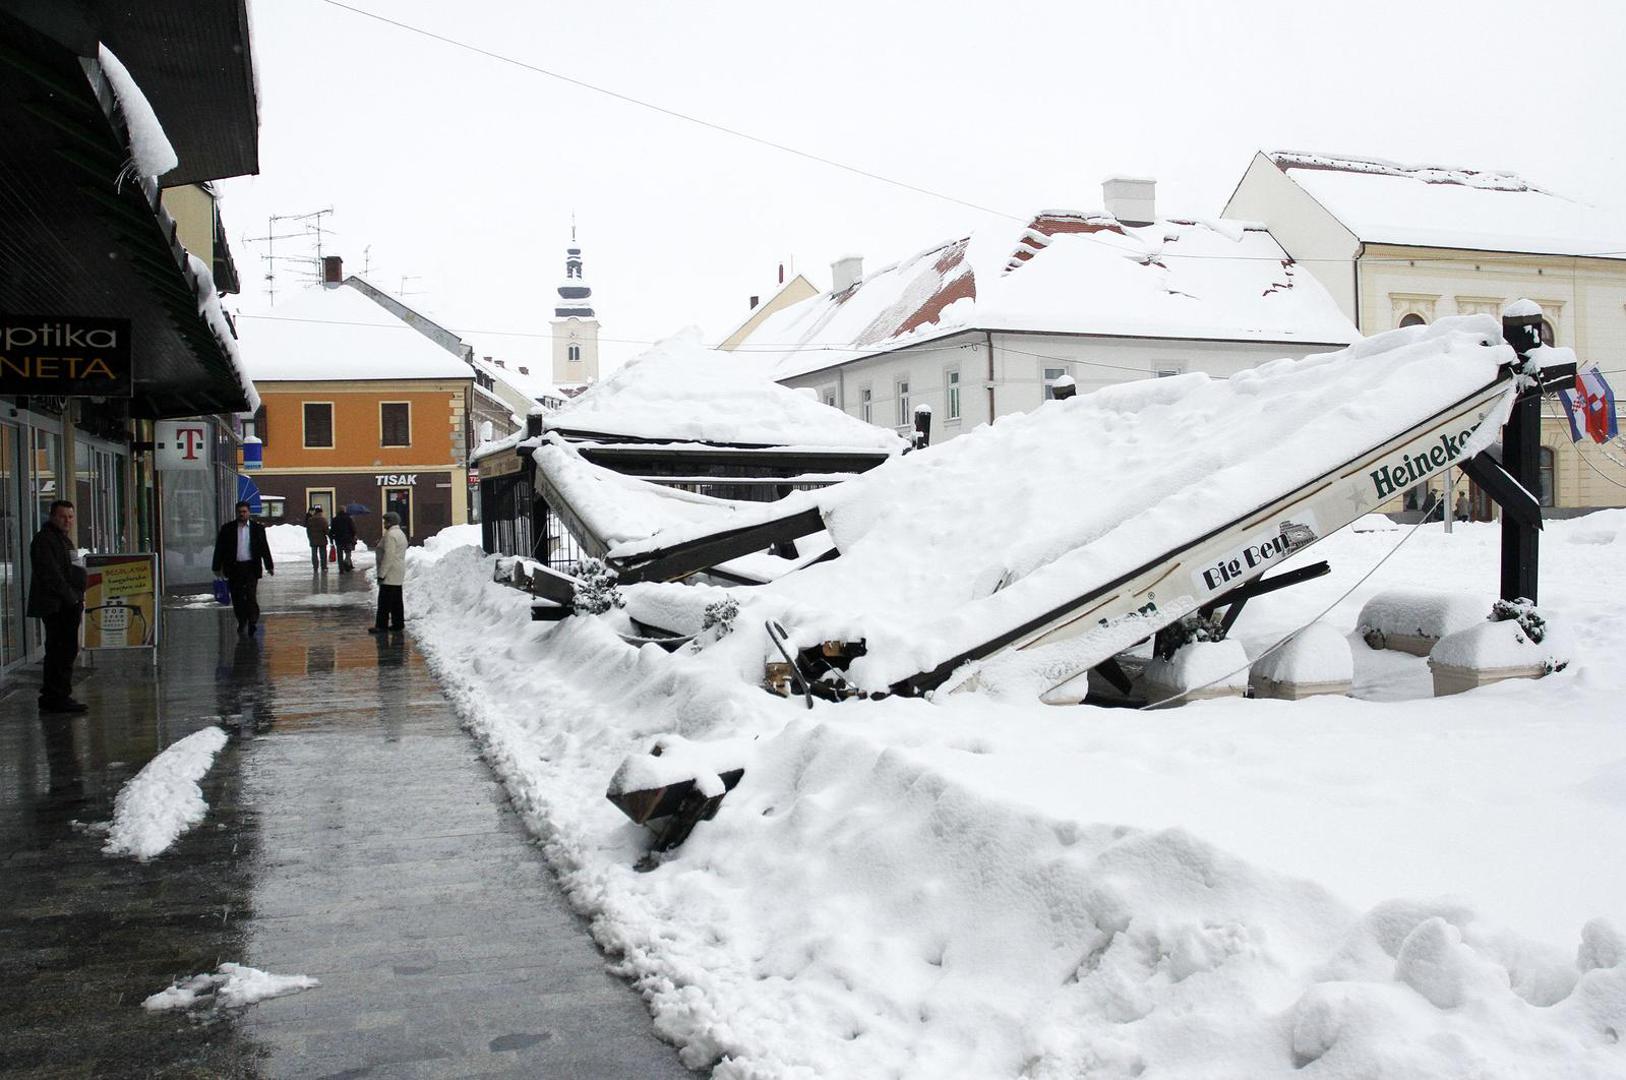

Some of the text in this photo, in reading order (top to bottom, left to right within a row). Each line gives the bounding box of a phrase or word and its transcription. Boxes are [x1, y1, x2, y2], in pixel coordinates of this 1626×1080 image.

[0, 322, 118, 352] ptika
[176, 429, 203, 460] T
[375, 474, 418, 486] TISAK
[1202, 533, 1290, 591] Big Ben
